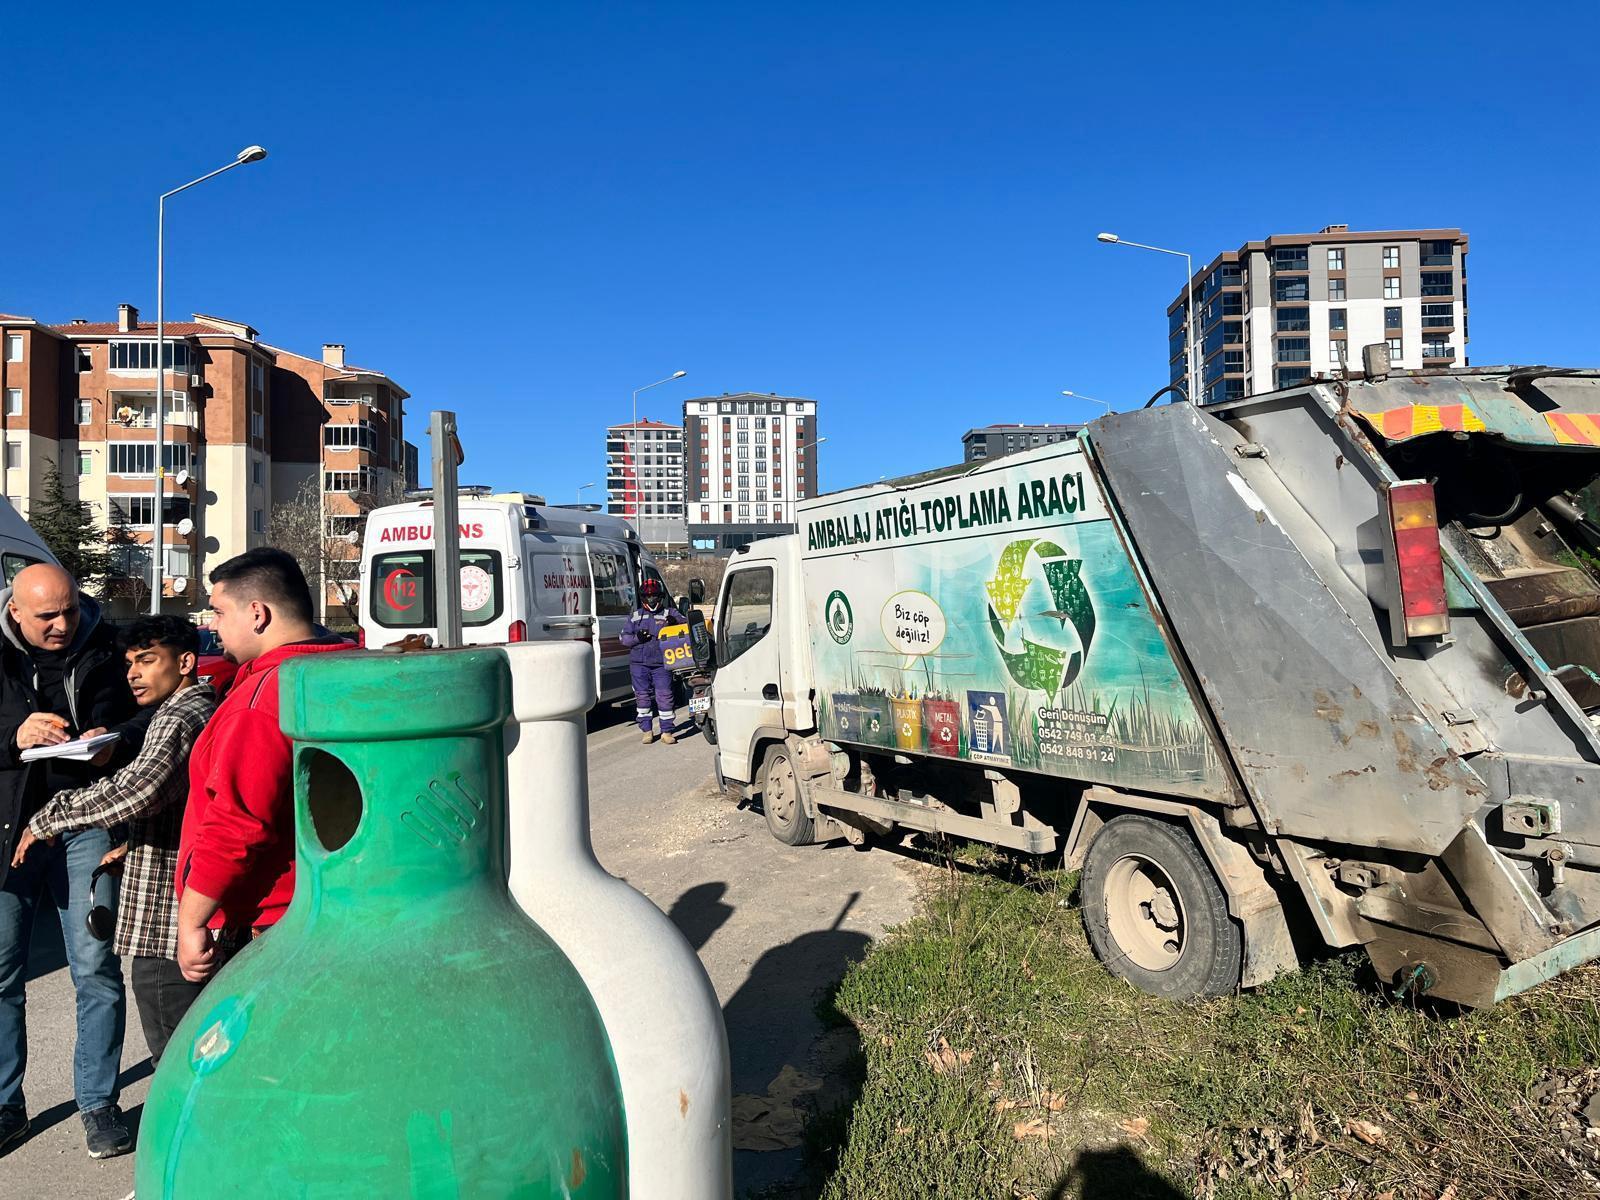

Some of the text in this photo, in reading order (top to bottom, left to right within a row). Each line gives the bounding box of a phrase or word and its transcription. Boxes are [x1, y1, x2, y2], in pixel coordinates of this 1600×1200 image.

[808, 472, 1086, 551] AMBALAJ ATIĞI TOPLAMA ARACI
[380, 523, 484, 543] AMBUNS
[392, 581, 416, 598] 112
[561, 591, 579, 615] 112
[895, 603, 930, 628] Biz çöp
[895, 625, 930, 644] değiliz!
[934, 712, 955, 725] METAL
[1039, 707, 1107, 726] Geri Dönüşüm
[1038, 727, 1063, 740] 0542
[1064, 730, 1082, 742] 749
[1040, 742, 1115, 763] 0542 848 91 24
